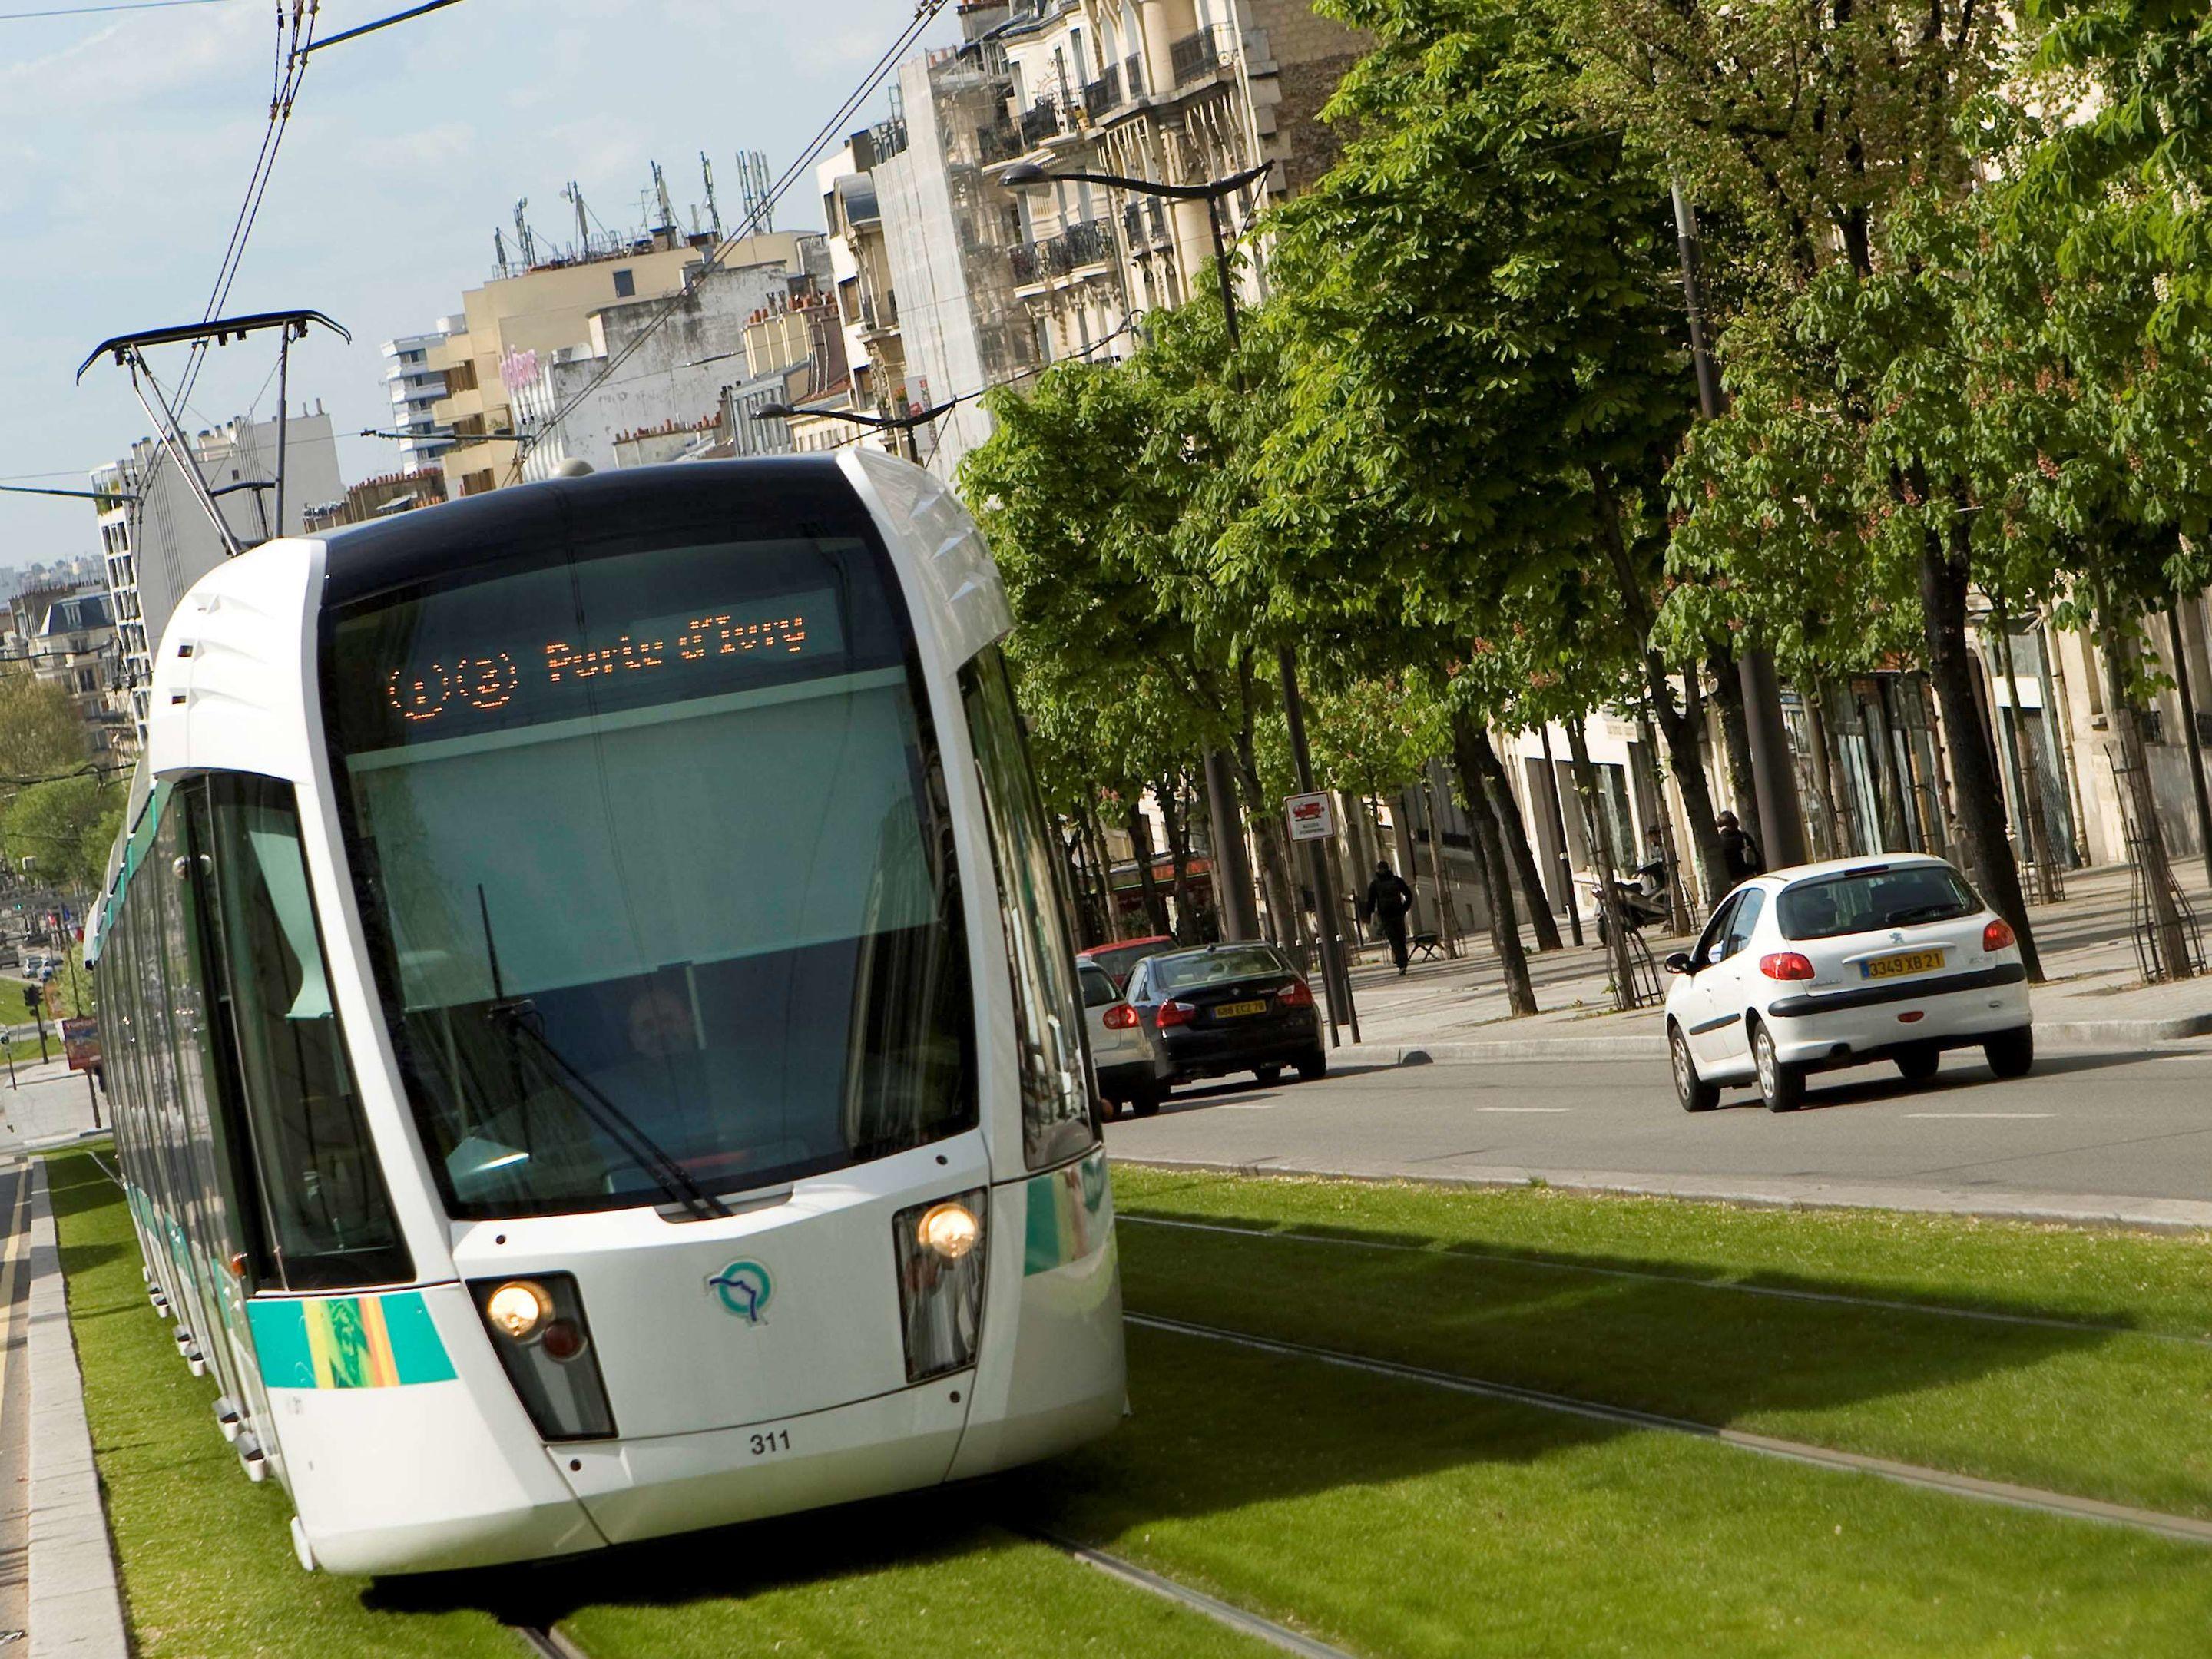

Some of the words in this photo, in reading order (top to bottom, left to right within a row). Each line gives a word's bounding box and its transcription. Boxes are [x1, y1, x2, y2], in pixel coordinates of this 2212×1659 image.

[1870, 959, 1902, 977] 3349
[1924, 952, 1942, 968] 21
[750, 1429, 790, 1455] 311
